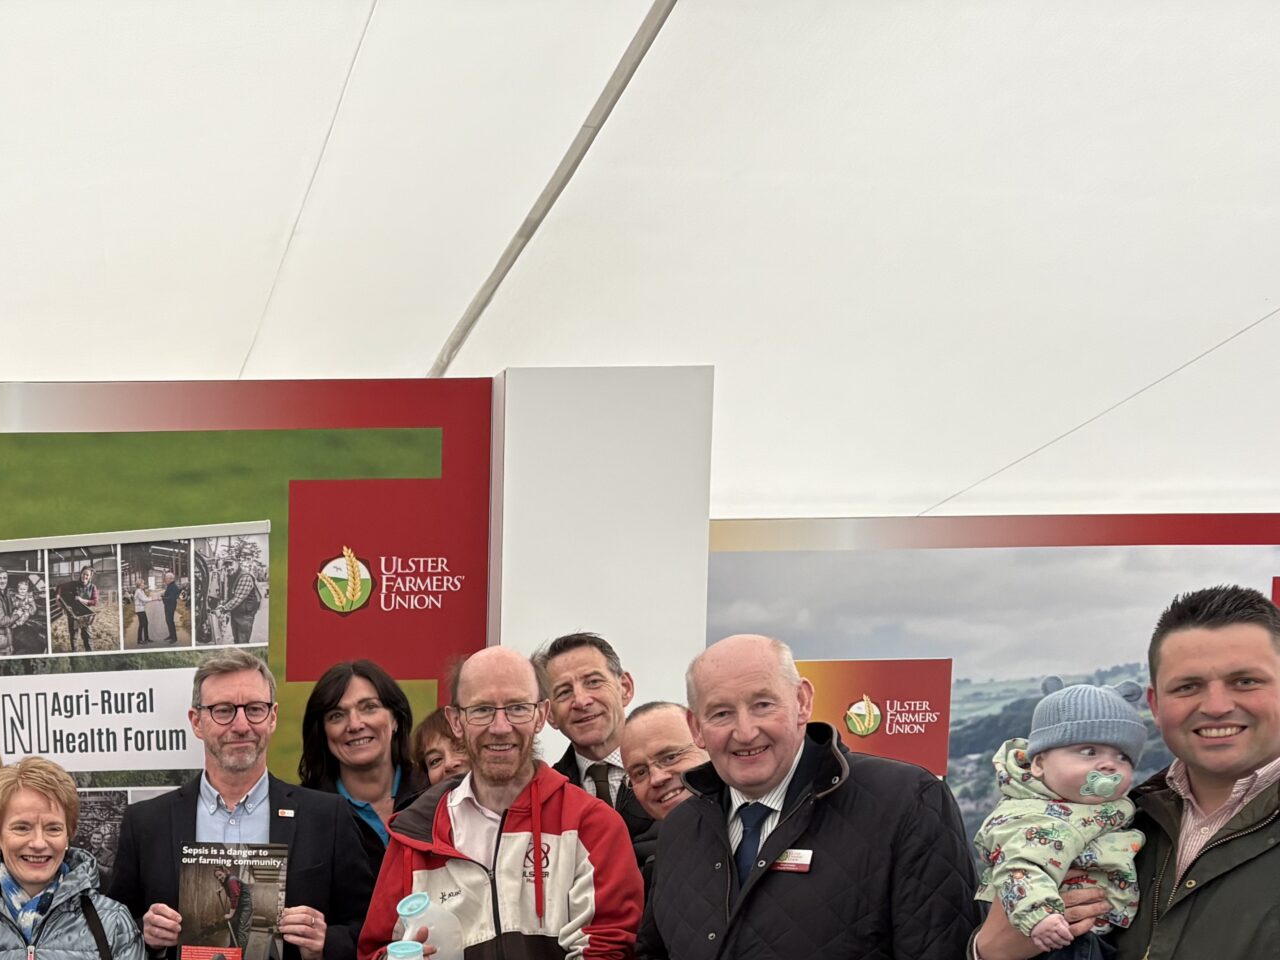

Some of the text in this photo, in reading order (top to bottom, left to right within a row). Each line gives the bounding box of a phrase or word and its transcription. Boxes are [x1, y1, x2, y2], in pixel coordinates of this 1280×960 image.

[380, 556, 451, 575] ULSTER
[380, 574, 465, 594] FARMERS'
[380, 593, 442, 611] UNION
[51, 688, 154, 718] Agri-Rural
[885, 700, 931, 713] ULSTER
[2, 692, 51, 755] NI
[885, 723, 925, 735] UNION
[52, 726, 187, 754] Health Forum
[182, 845, 209, 857] Sepsis
[211, 846, 218, 855] is
[226, 847, 258, 858] danger
[199, 856, 232, 867] farming
[233, 858, 284, 868] community.
